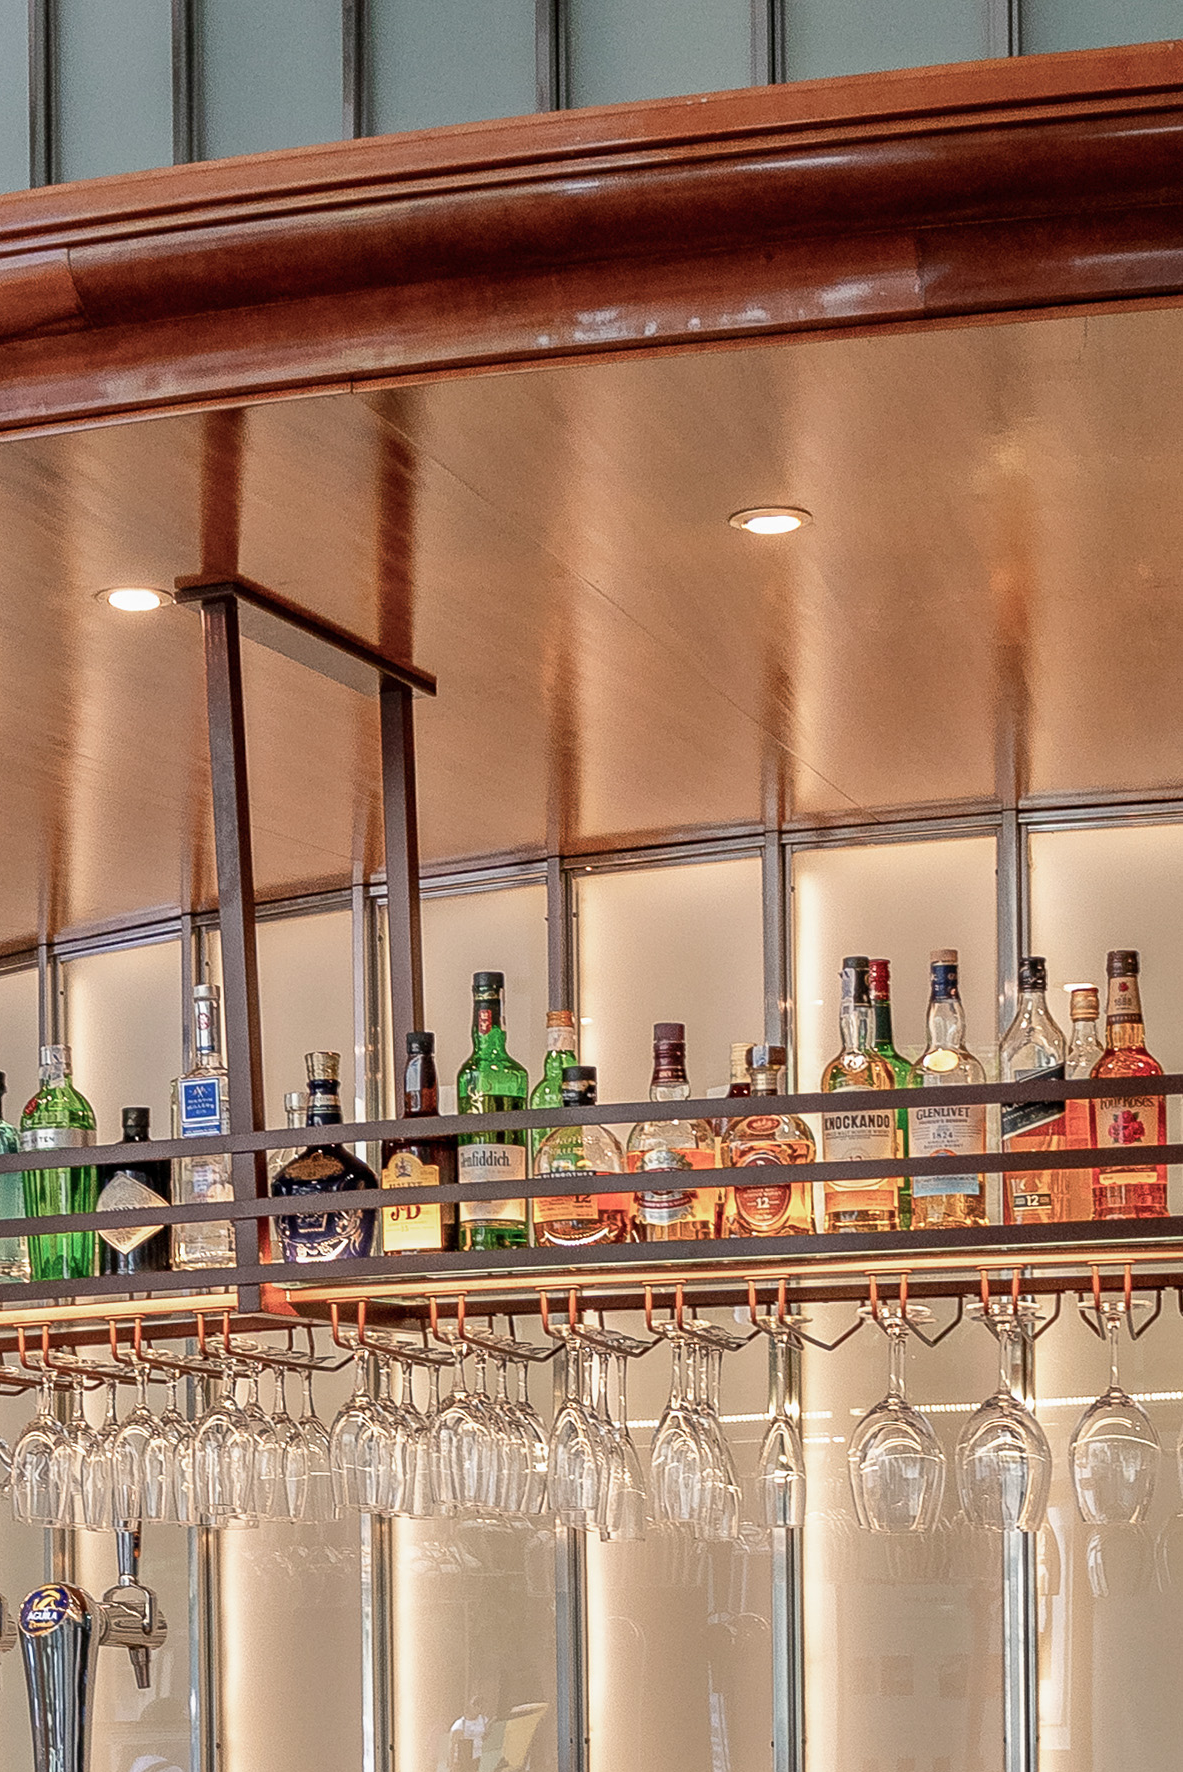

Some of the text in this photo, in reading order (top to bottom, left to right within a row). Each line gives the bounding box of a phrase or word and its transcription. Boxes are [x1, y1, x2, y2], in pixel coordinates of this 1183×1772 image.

[916, 1107, 970, 1120] GLENLIVET
[756, 1197, 770, 1208] 12
[1026, 1196, 1039, 1205] 12
